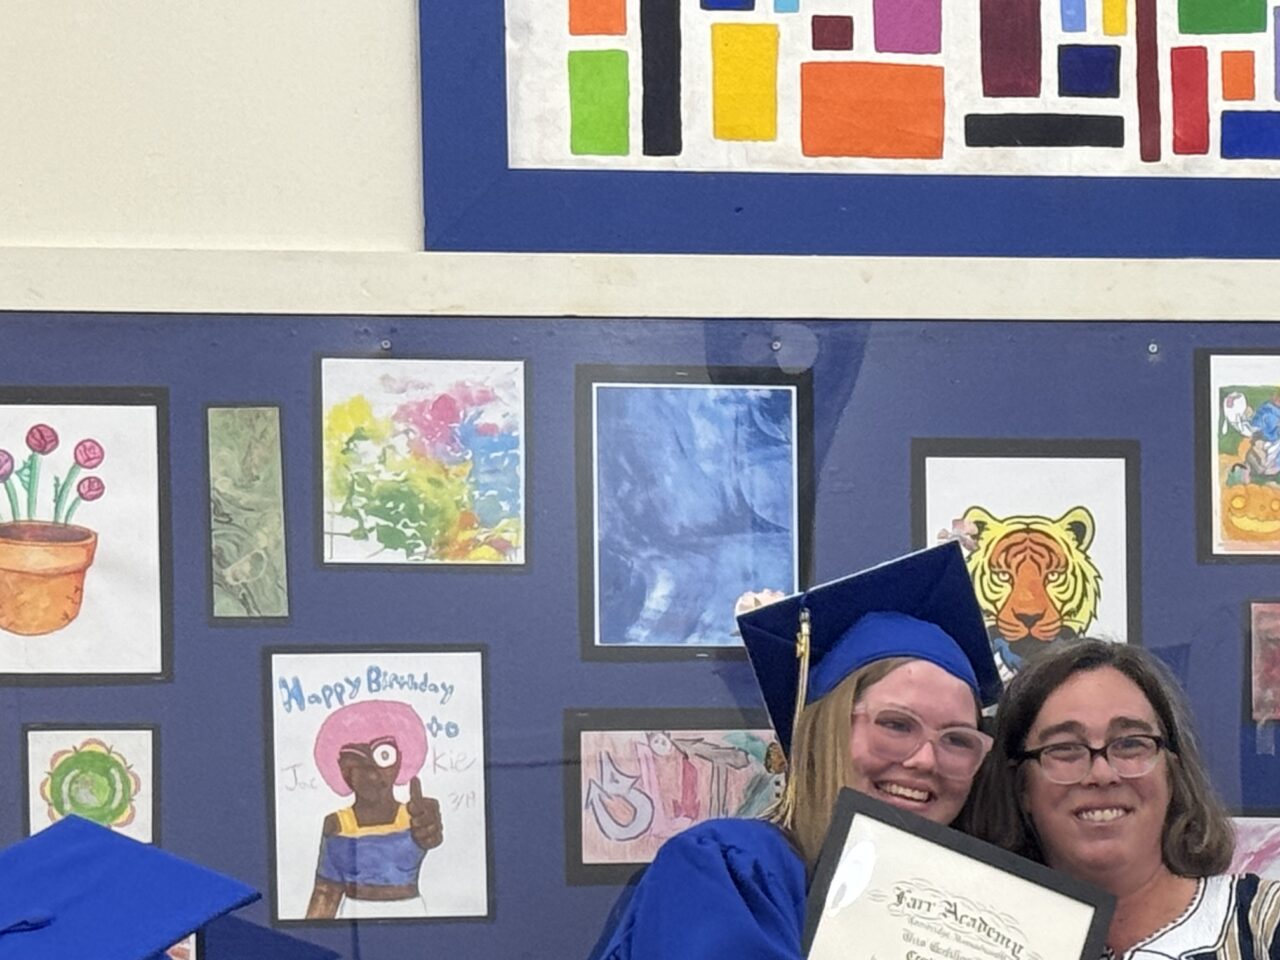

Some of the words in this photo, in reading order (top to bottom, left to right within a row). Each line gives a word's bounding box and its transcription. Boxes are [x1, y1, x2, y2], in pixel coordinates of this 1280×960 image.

[278, 675, 361, 713] Happy
[366, 665, 455, 705] Birthday
[426, 715, 459, 739] to
[894, 887, 933, 914] Farr
